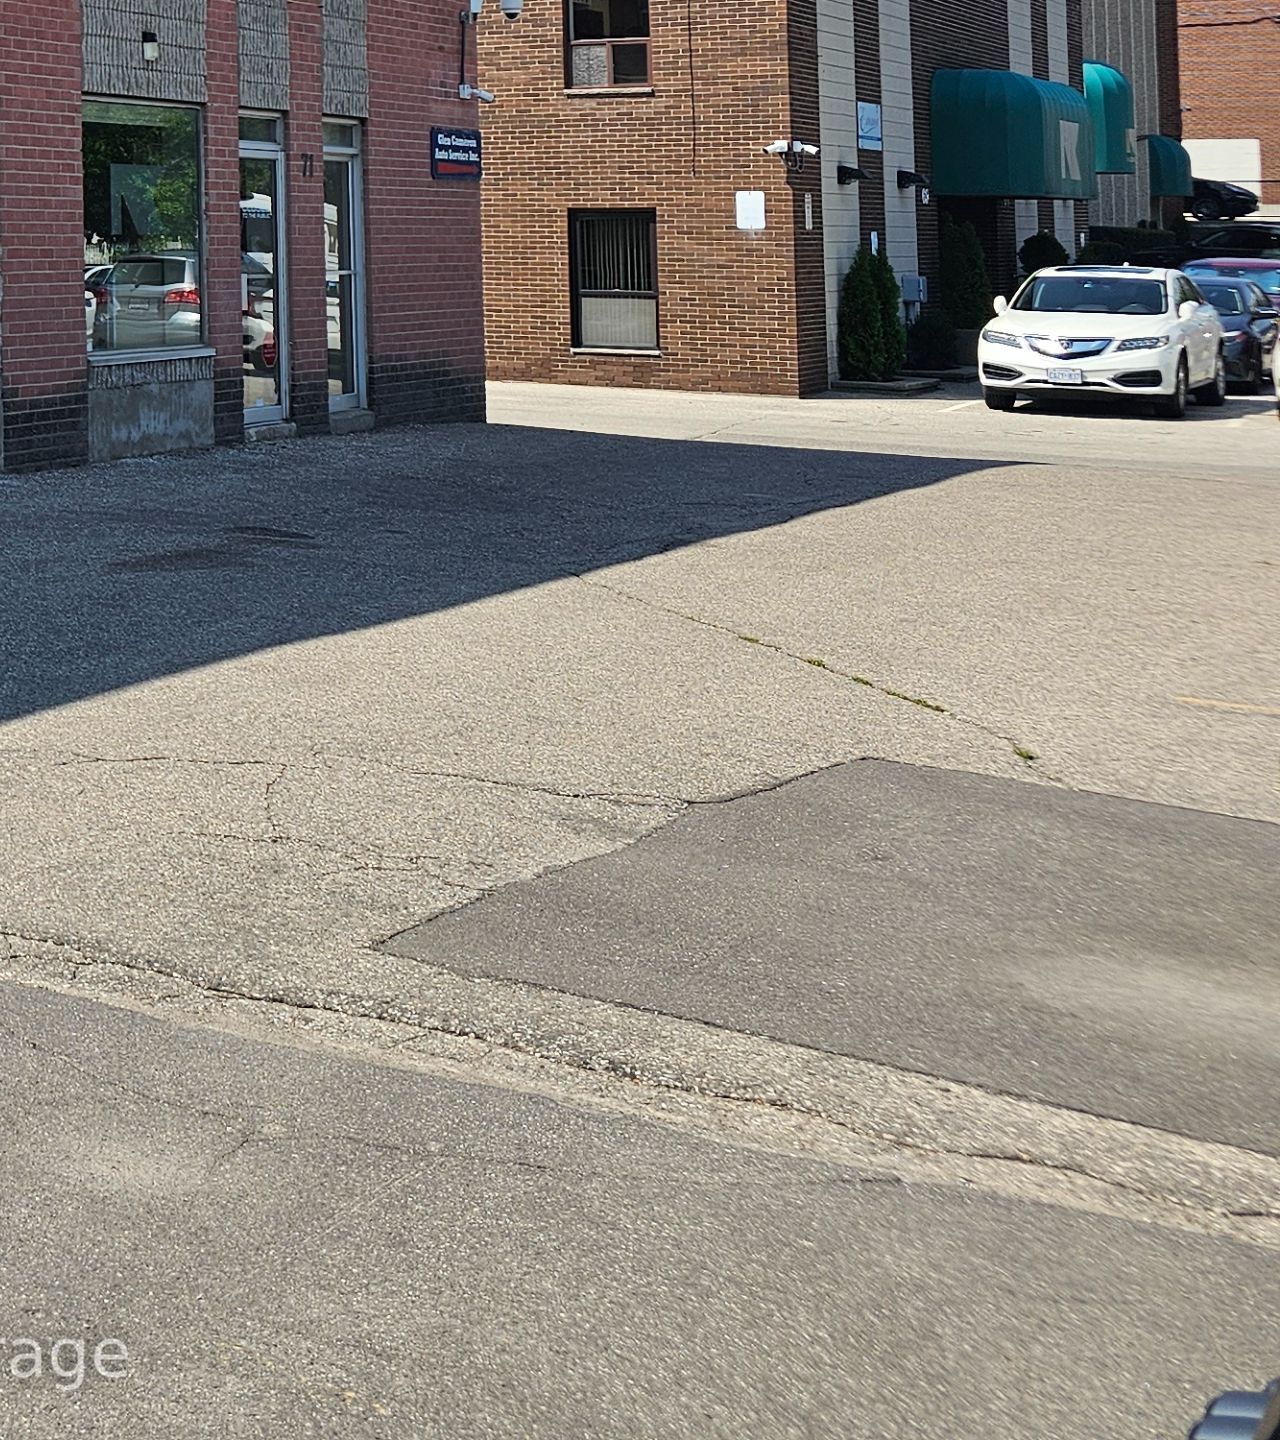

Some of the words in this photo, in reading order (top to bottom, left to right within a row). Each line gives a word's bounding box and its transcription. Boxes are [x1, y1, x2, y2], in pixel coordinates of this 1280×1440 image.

[438, 133, 450, 145] Glen
[435, 148, 448, 159] Auto
[449, 149, 468, 160] Service
[301, 153, 314, 177] 71
